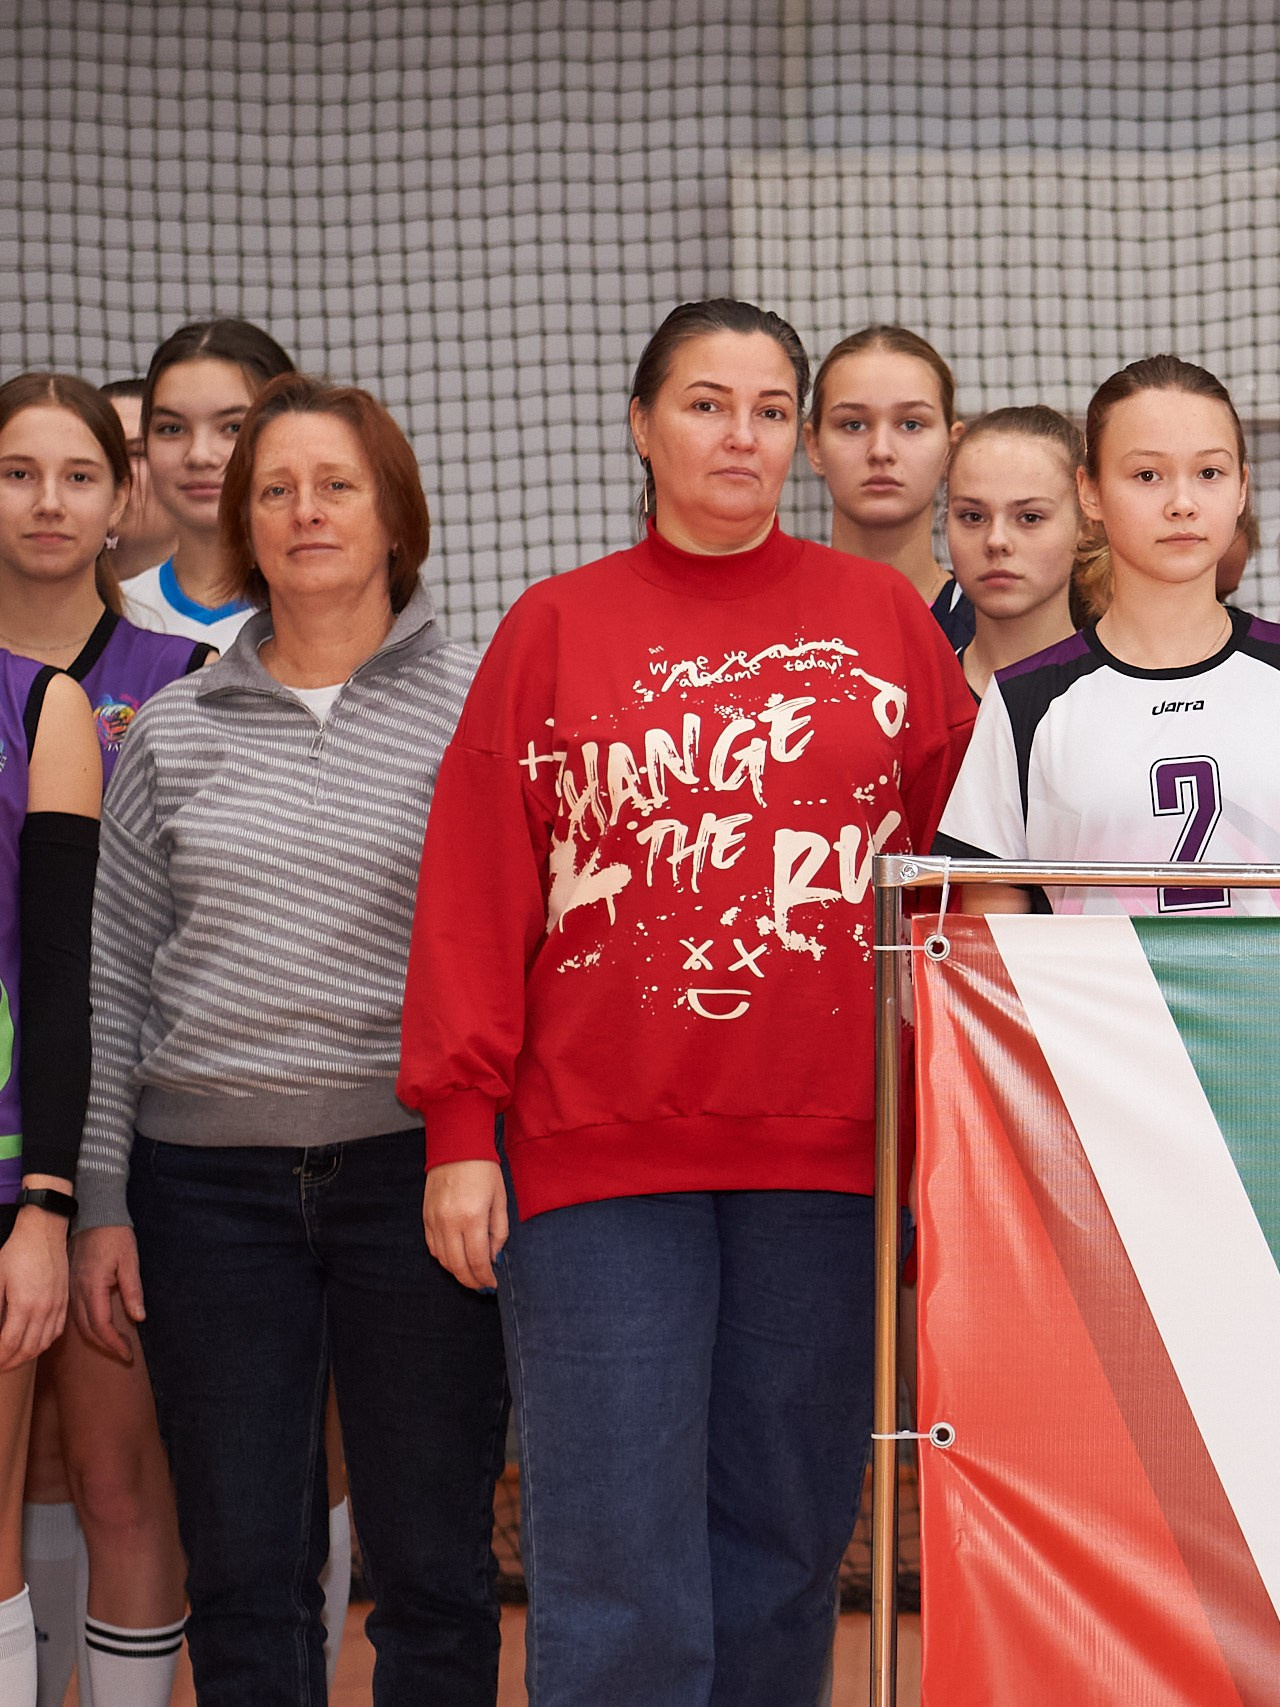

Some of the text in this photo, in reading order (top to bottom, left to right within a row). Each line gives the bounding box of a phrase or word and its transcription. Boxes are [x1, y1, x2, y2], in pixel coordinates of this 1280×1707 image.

[553, 696, 816, 842] HANGE
[1149, 754, 1231, 913] 2
[636, 812, 753, 894] THE
